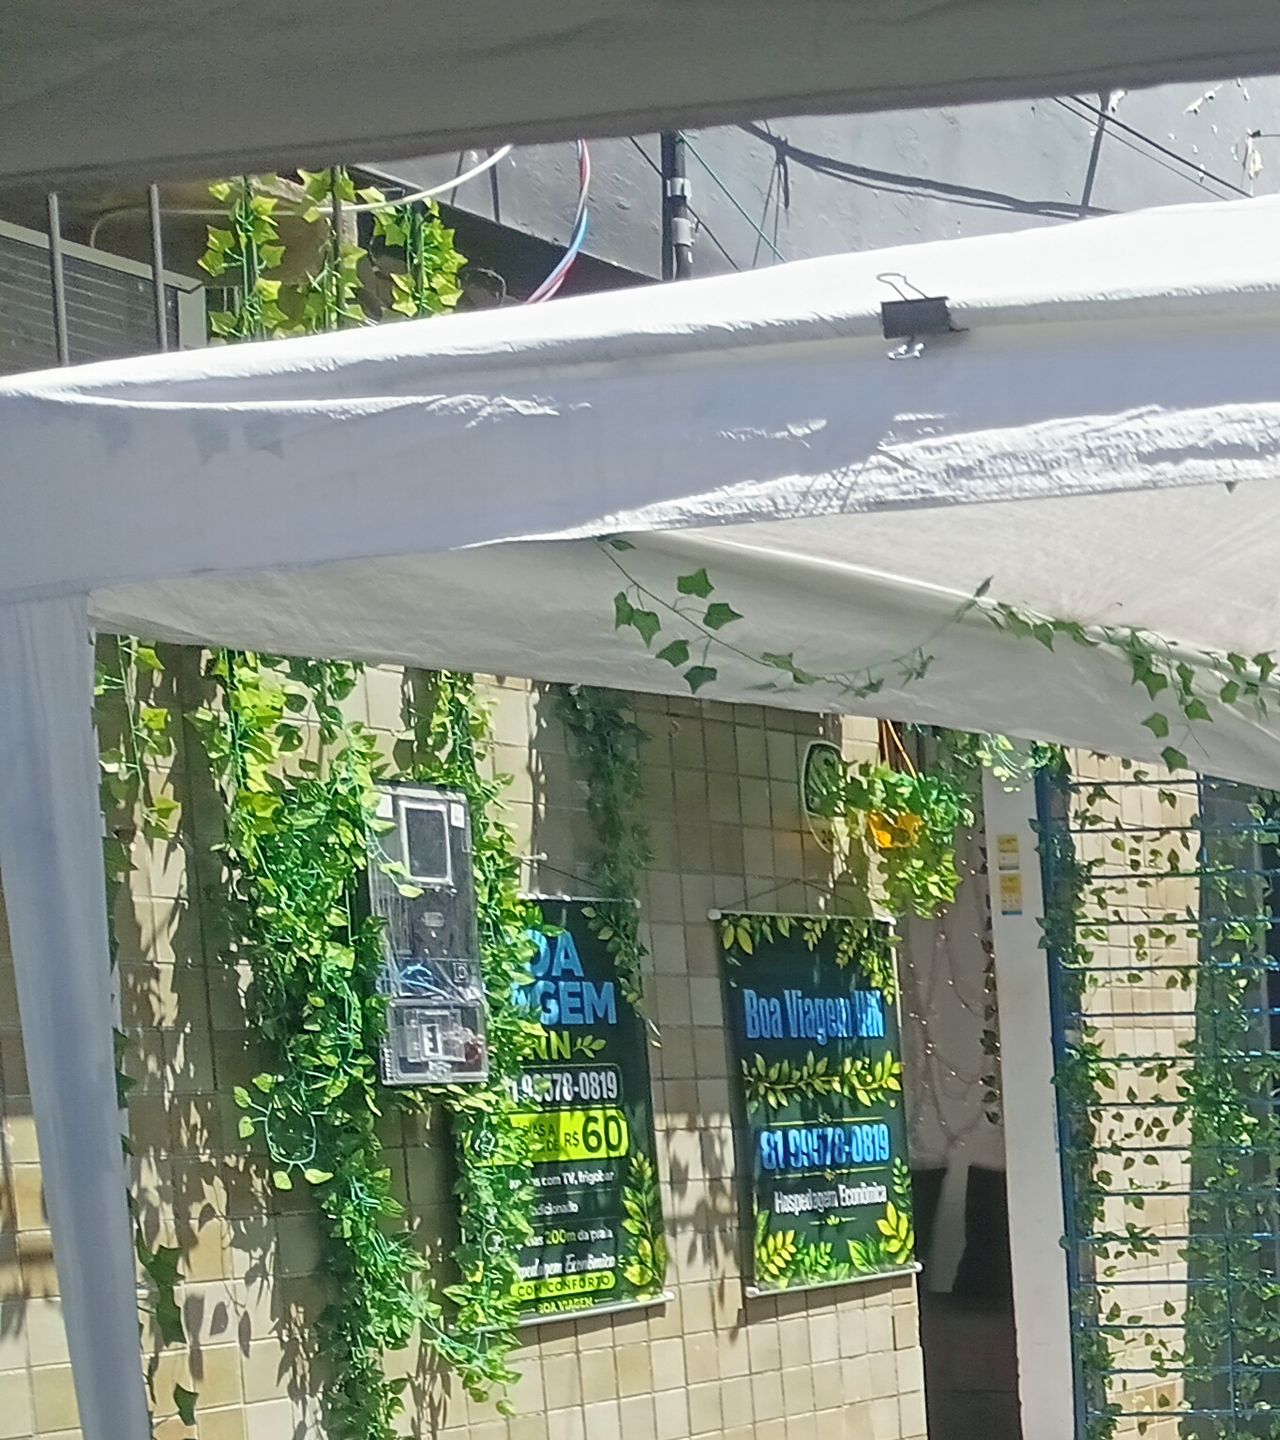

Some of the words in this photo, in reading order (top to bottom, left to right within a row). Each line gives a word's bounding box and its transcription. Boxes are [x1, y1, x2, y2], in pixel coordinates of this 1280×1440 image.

[742, 989, 784, 1039] Boa
[783, 989, 853, 1046] Viagem
[564, 1130, 580, 1149] R$
[582, 1114, 623, 1153] 60
[760, 1129, 786, 1170] 81
[787, 1123, 890, 1168] 99578-0819
[541, 1175, 561, 1187] com
[773, 1187, 839, 1216] Hospedagem
[837, 1181, 888, 1208] Econômica
[577, 1229, 590, 1242] da
[589, 1227, 614, 1242] praia
[517, 1281, 542, 1297] COM
[546, 1274, 610, 1293] CONFORTO
